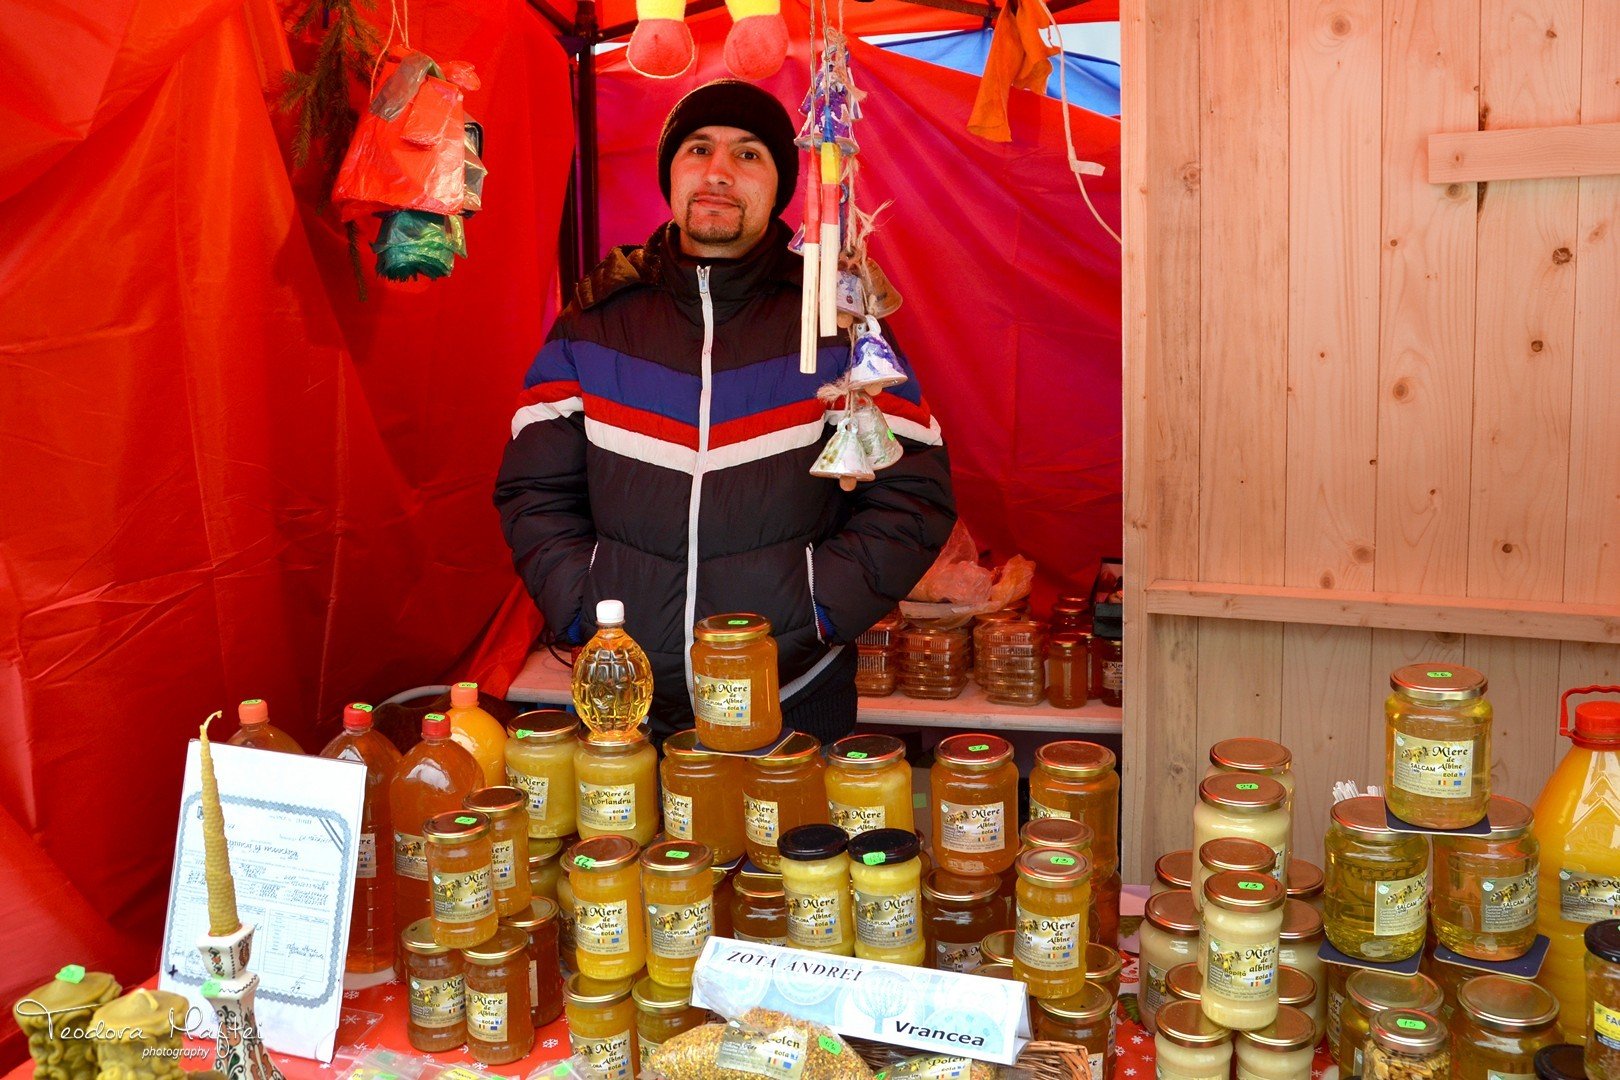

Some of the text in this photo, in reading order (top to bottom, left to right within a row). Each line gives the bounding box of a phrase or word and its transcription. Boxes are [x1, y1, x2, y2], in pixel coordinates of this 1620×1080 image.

[718, 684, 748, 694] Miere
[1432, 746, 1468, 758] Miere
[1410, 763, 1436, 772] SALCAM
[1438, 763, 1462, 771] Albine
[520, 776, 546, 787] Miere
[591, 798, 632, 806] Coriandru
[668, 792, 689, 808] Miere
[750, 801, 774, 814] Miere
[972, 808, 1001, 818] Miere
[852, 810, 882, 820] Miere
[857, 823, 877, 831] Albine
[977, 822, 997, 830] Albine
[491, 845, 510, 854] iere
[464, 870, 490, 886] Miere
[802, 898, 836, 908] Miere
[884, 896, 914, 910] Miere
[588, 906, 623, 918] Miere
[684, 904, 711, 920] Miere
[809, 912, 832, 921] Albine
[890, 912, 911, 922] Albine
[596, 922, 618, 930] Albine
[690, 920, 710, 931] Albine
[1041, 920, 1076, 932] Miere
[1047, 936, 1070, 945] Albine
[1245, 946, 1276, 960] Miere
[726, 950, 863, 982] ZOTA ANDREI
[1249, 962, 1274, 972] albine
[474, 995, 503, 1006] Miere
[896, 1020, 986, 1047] Vrancea
[595, 1039, 628, 1054] Miere
[602, 1054, 624, 1066] Albine
